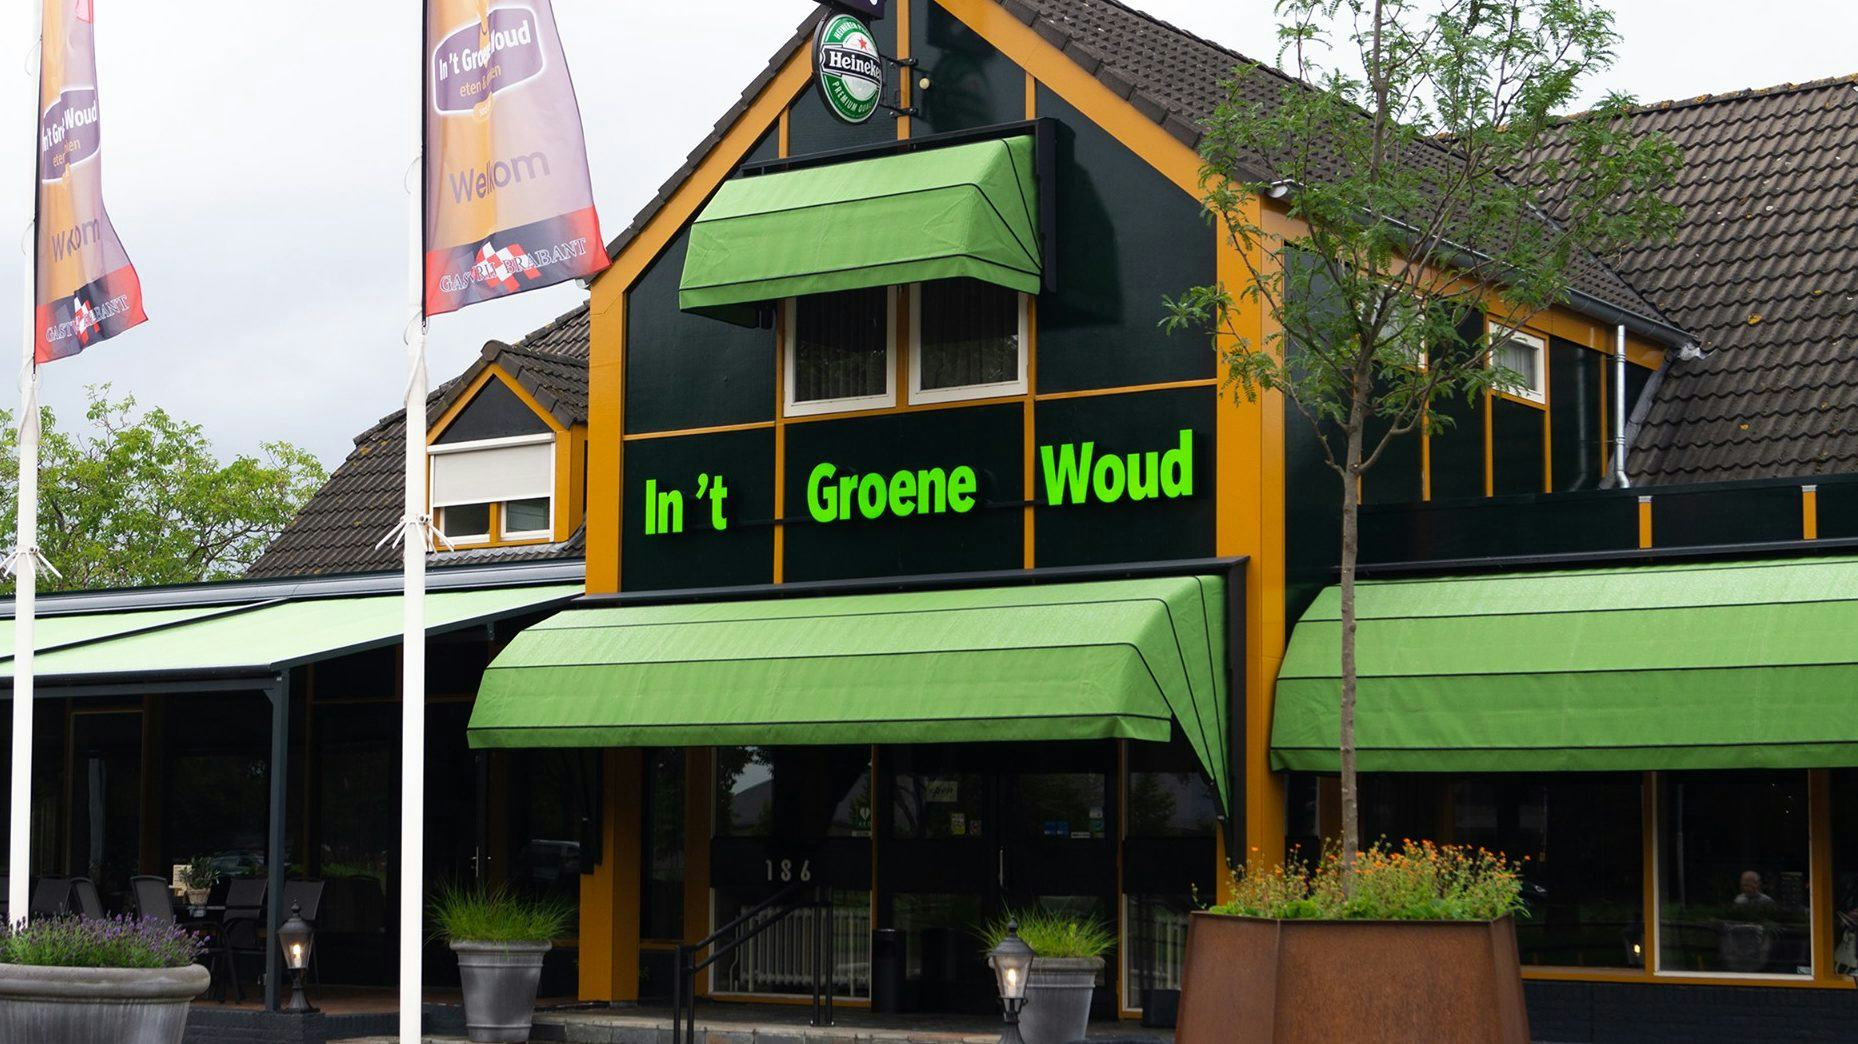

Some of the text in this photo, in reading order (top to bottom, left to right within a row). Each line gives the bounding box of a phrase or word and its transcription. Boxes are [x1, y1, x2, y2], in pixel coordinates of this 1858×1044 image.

[829, 50, 881, 80] Heineke
[832, 81, 859, 112] PREMIUM
[64, 100, 97, 130] Woud
[450, 151, 550, 204] Welkom
[52, 219, 100, 262] Wkom
[503, 237, 586, 275] BRABANT
[645, 479, 683, 535] In
[807, 462, 977, 523] Groene
[1040, 429, 1193, 506] Woud
[765, 859, 811, 881] 186
